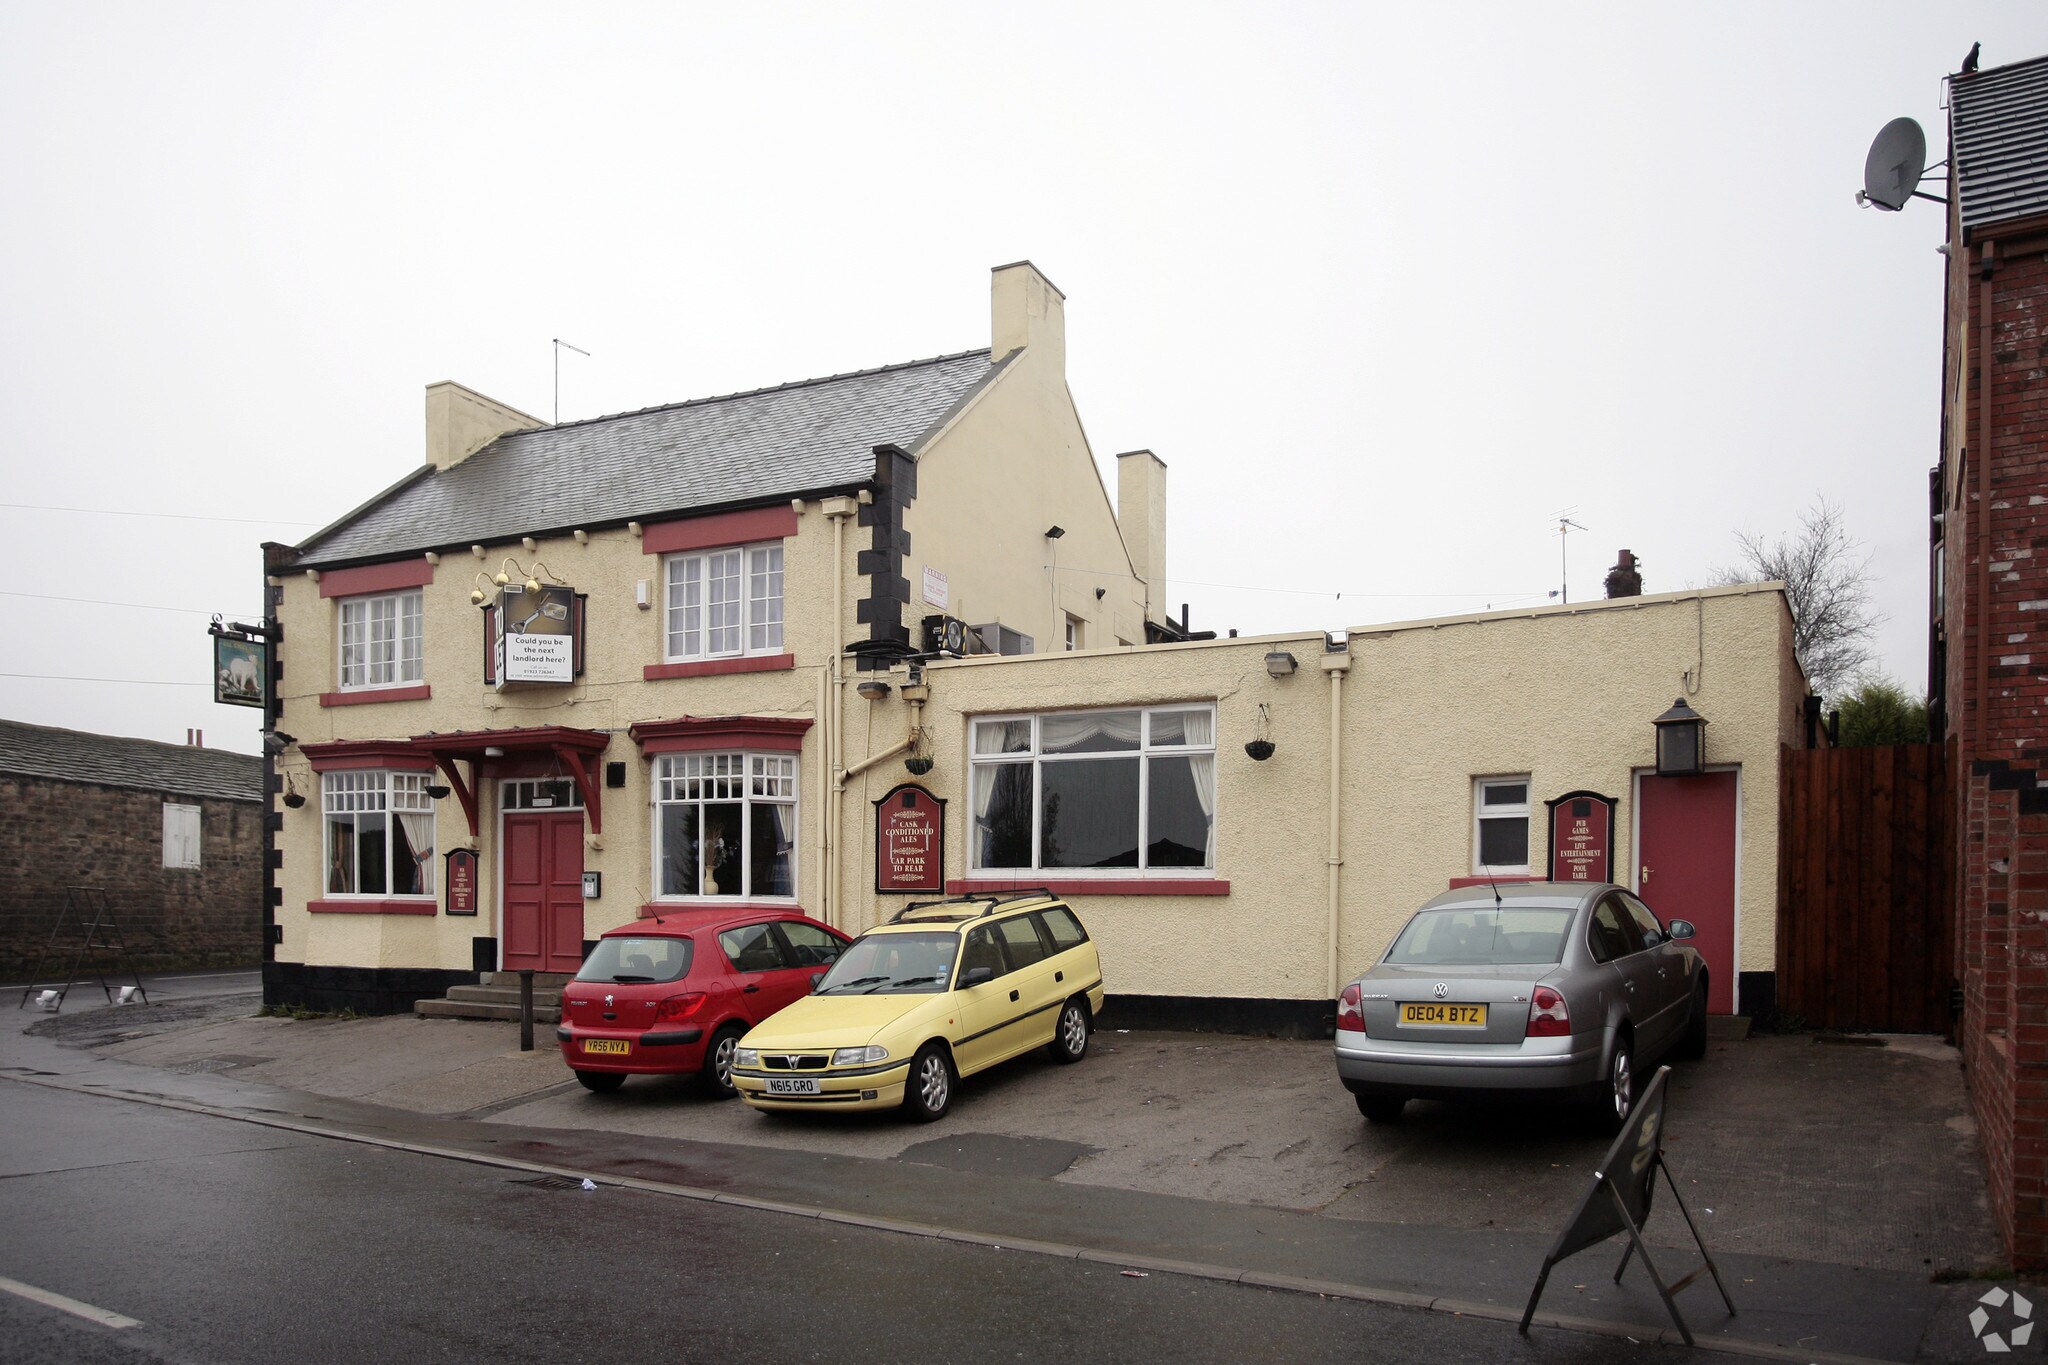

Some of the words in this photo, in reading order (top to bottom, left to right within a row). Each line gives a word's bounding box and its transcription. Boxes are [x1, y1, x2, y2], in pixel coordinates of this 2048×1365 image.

[494, 606, 504, 639] TO
[1407, 1006, 1444, 1021] OE04
[1448, 1007, 1479, 1022] BTZ
[588, 1040, 608, 1052] YR56
[609, 1041, 625, 1052] NYA
[770, 1080, 792, 1092] N615
[793, 1080, 814, 1092] GRO
